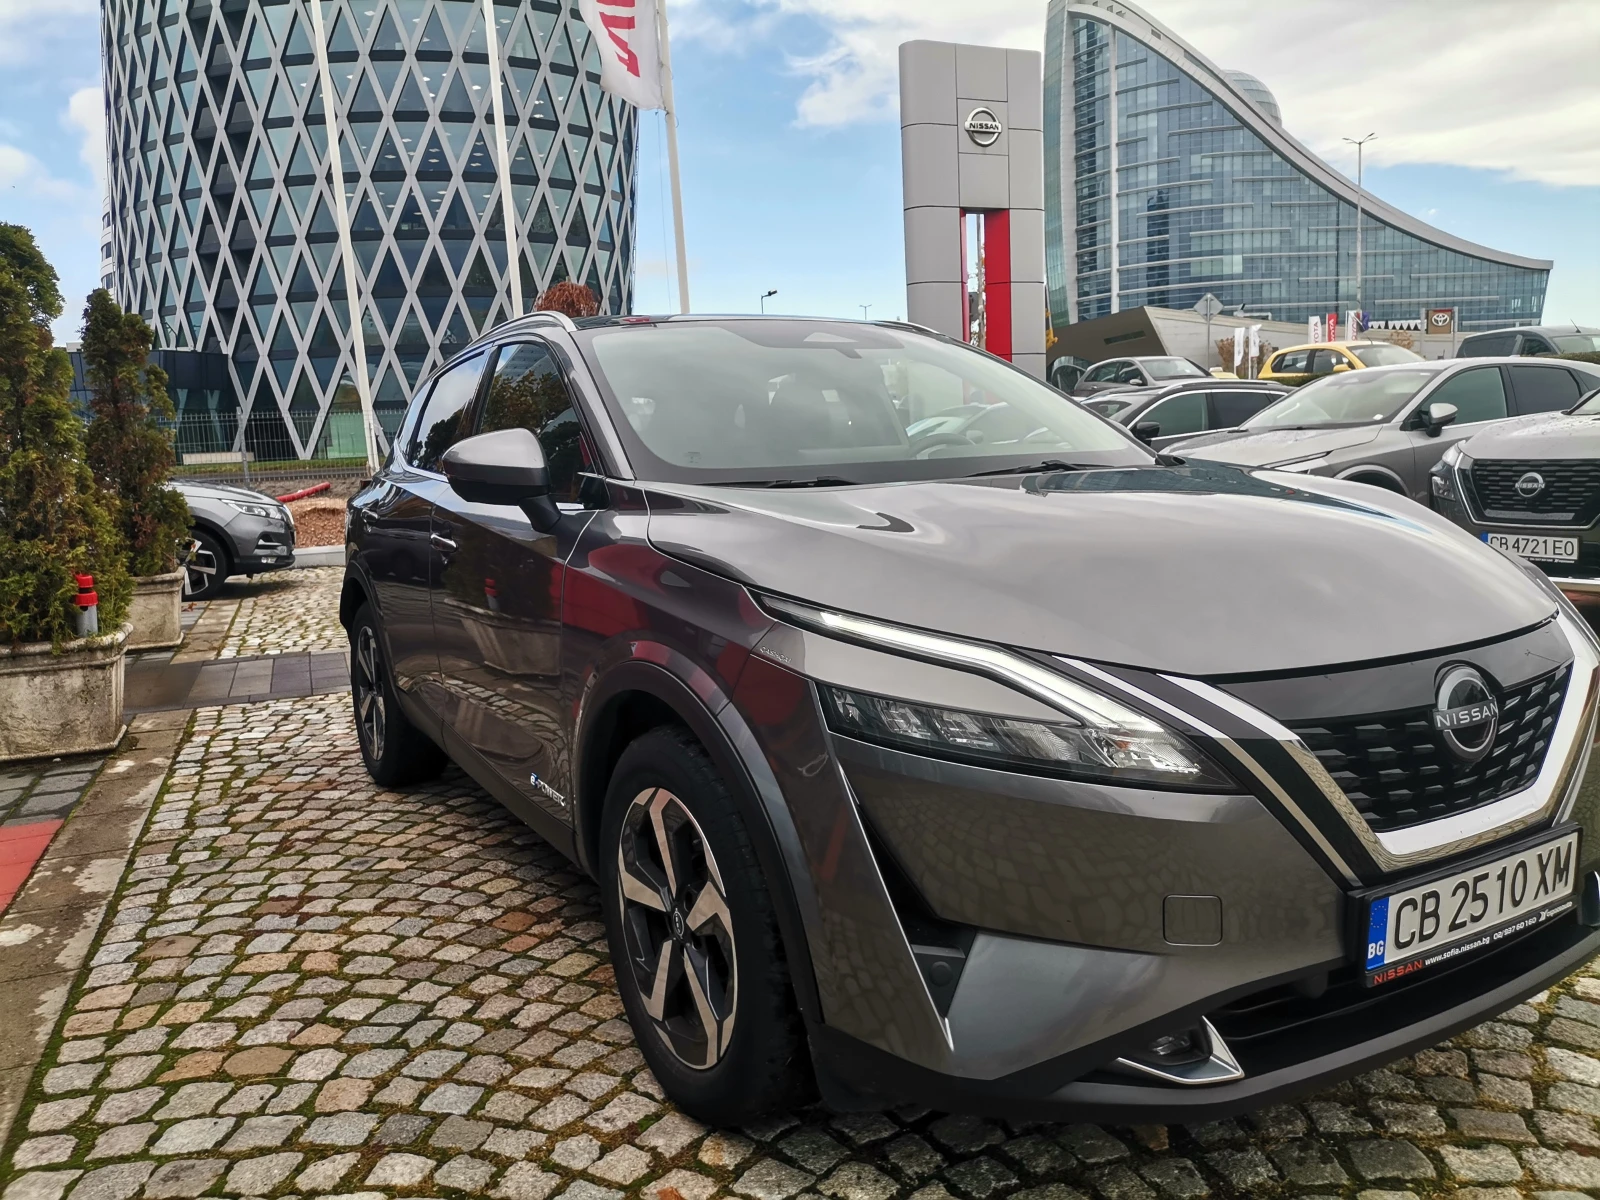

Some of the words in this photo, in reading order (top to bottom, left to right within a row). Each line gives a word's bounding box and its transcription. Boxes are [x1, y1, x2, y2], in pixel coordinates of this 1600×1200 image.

[968, 122, 999, 131] NISSAN
[1511, 537, 1550, 555] 4721
[1436, 702, 1499, 728] NISSAN
[1394, 889, 1442, 951] CB
[1447, 858, 1528, 935] 2510
[1533, 840, 1573, 901] XM
[1367, 940, 1385, 960] BG
[1373, 959, 1424, 985] NISSAN
[1424, 936, 1490, 966] www.sofia.nissan.bg
